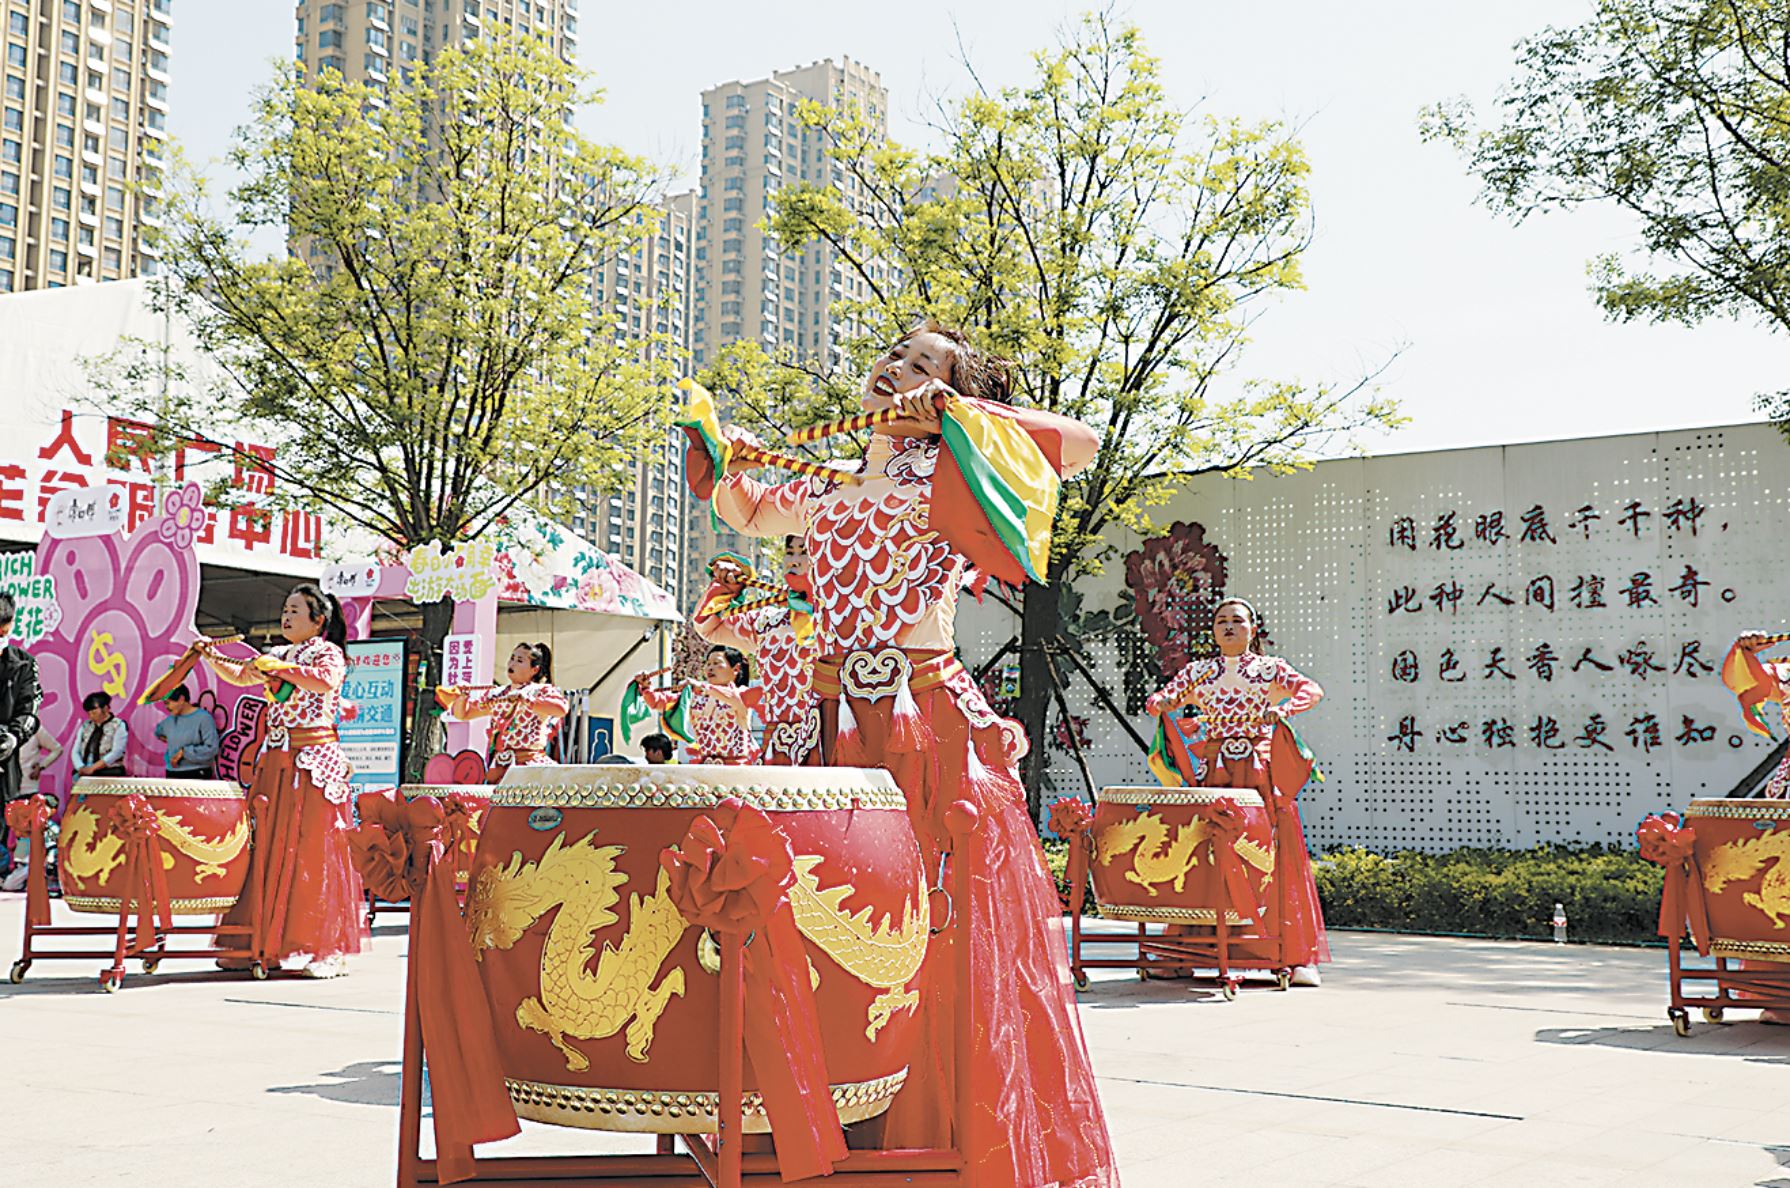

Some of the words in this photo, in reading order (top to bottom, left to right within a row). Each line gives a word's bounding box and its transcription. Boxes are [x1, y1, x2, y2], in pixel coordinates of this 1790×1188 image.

[38, 409, 277, 496] 人民广场
[0, 555, 33, 580] ICH
[0, 578, 54, 599] OWER
